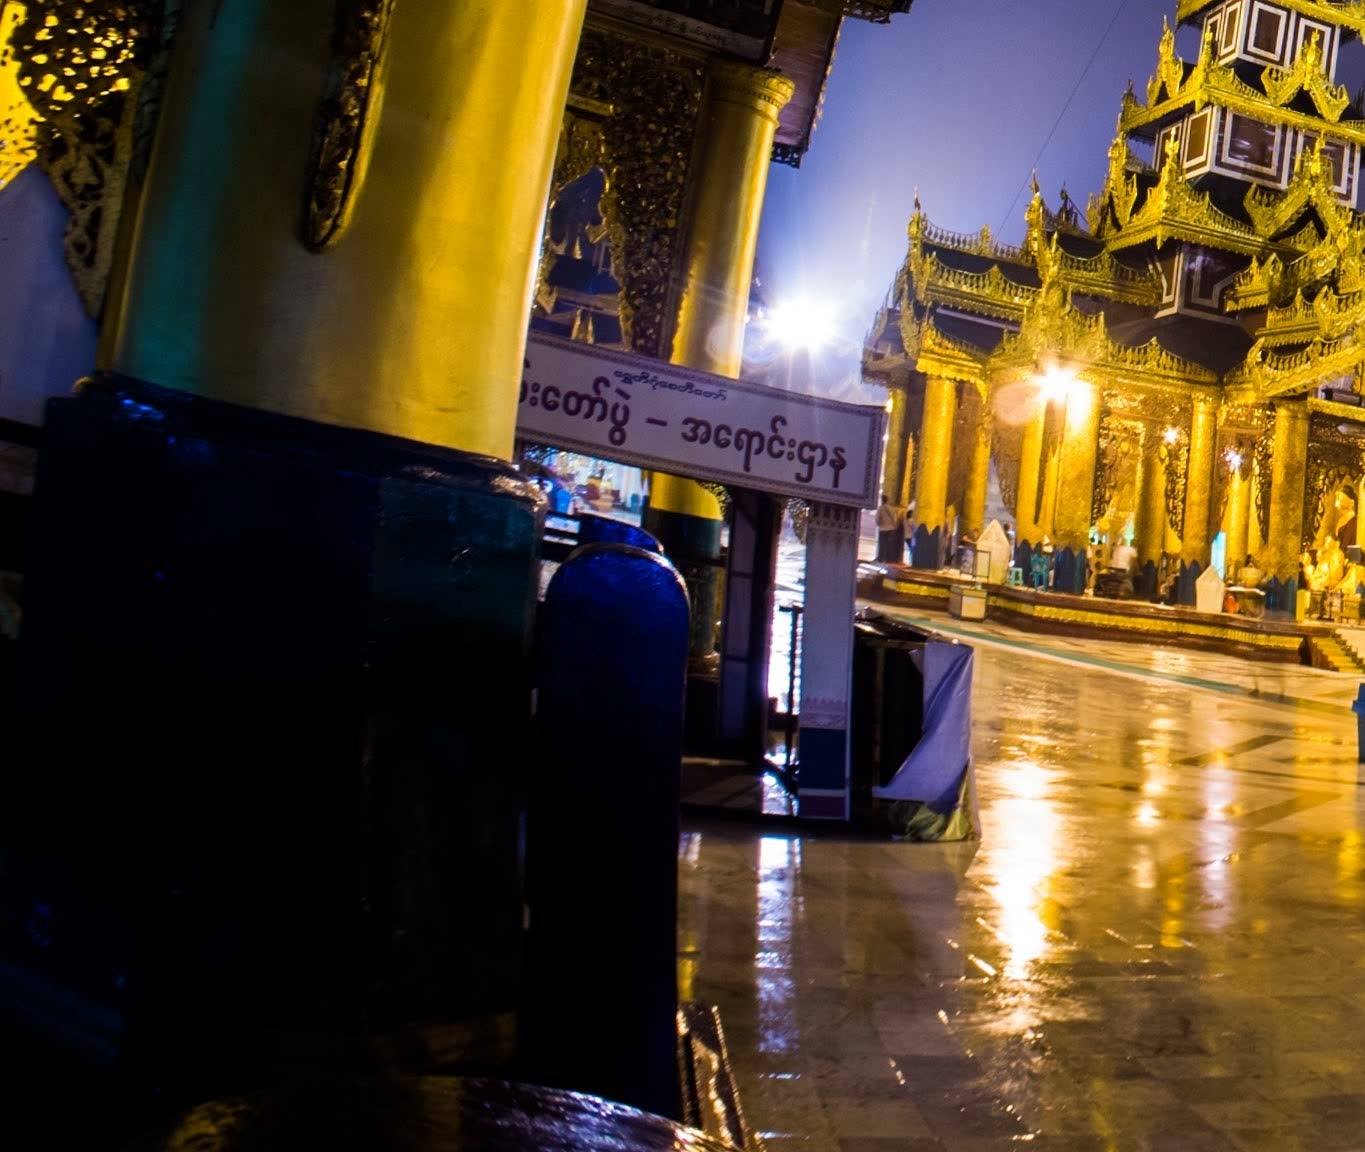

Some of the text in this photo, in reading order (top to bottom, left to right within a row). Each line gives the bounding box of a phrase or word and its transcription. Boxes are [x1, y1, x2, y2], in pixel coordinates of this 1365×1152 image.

[520, 357, 632, 447] းတော်ပွဲ
[681, 415, 847, 488] အရောင်းဌာန
